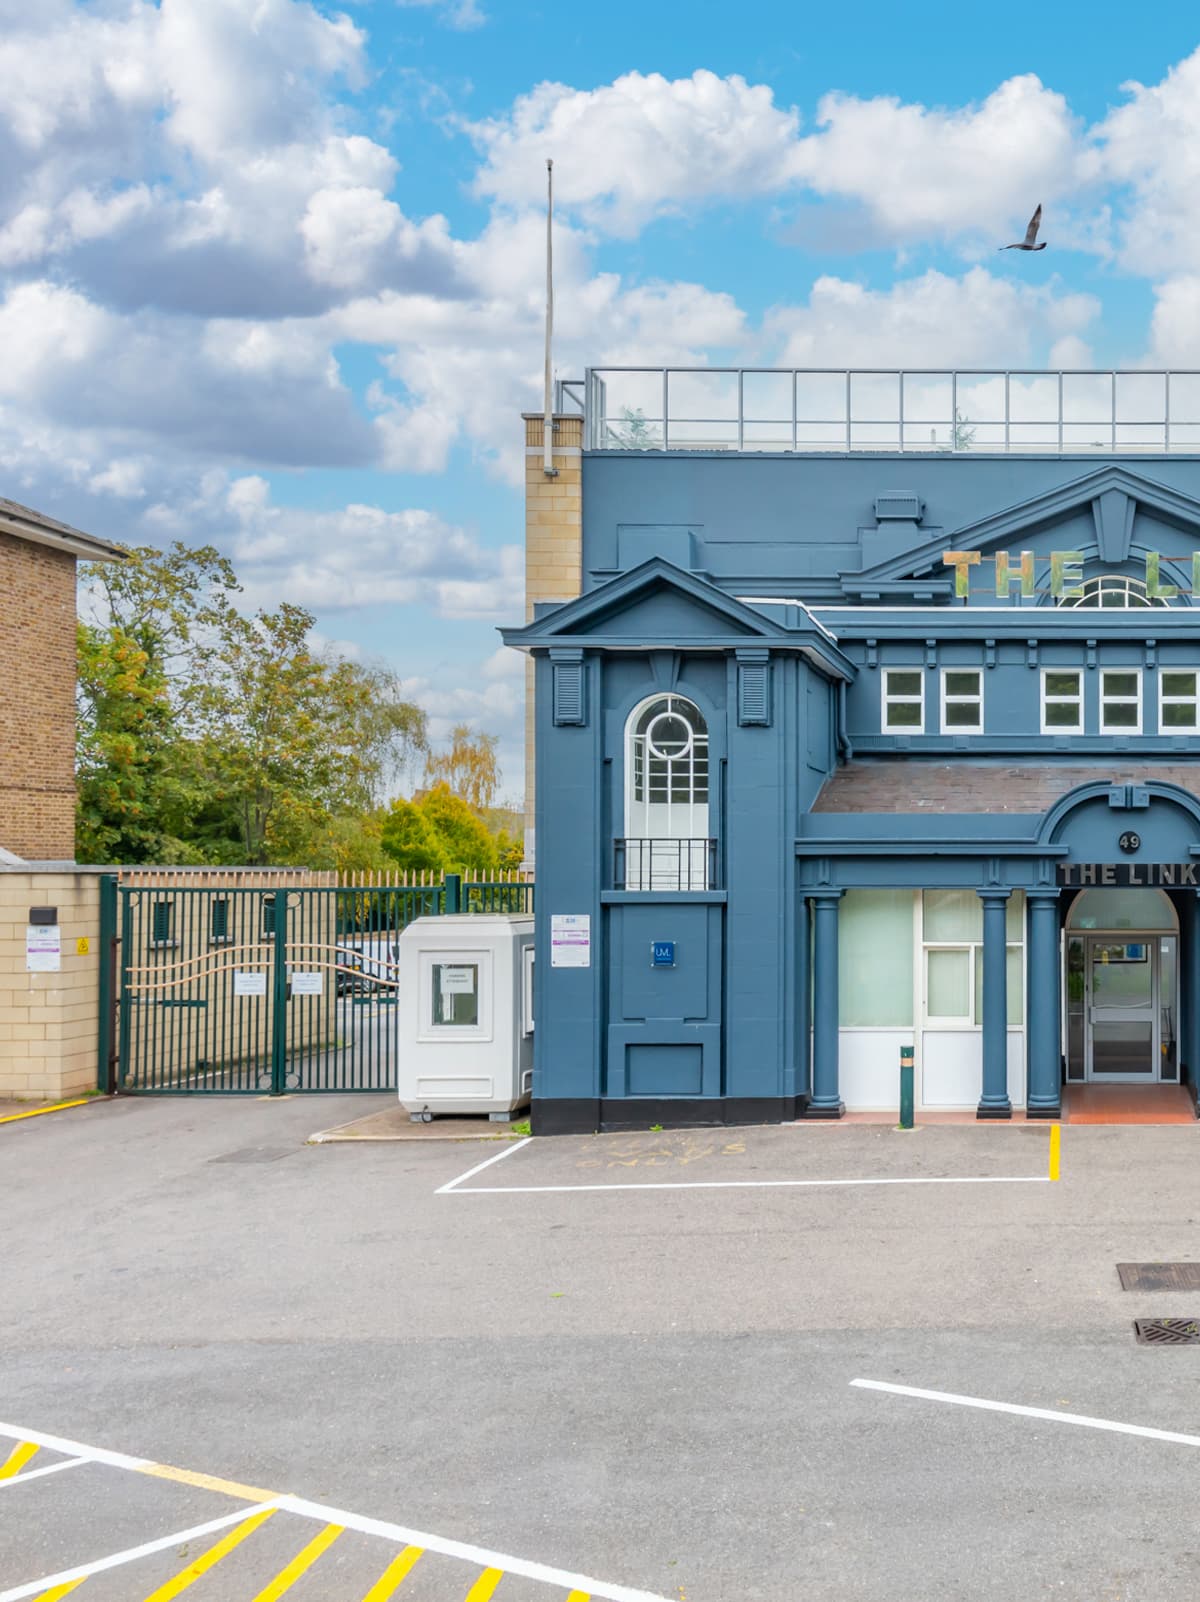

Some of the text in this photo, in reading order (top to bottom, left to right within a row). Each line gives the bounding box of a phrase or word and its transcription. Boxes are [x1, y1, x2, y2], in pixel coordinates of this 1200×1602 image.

[943, 551, 1085, 598] THE
[1119, 836, 1140, 848] 49
[1060, 864, 1198, 885] THE LINK
